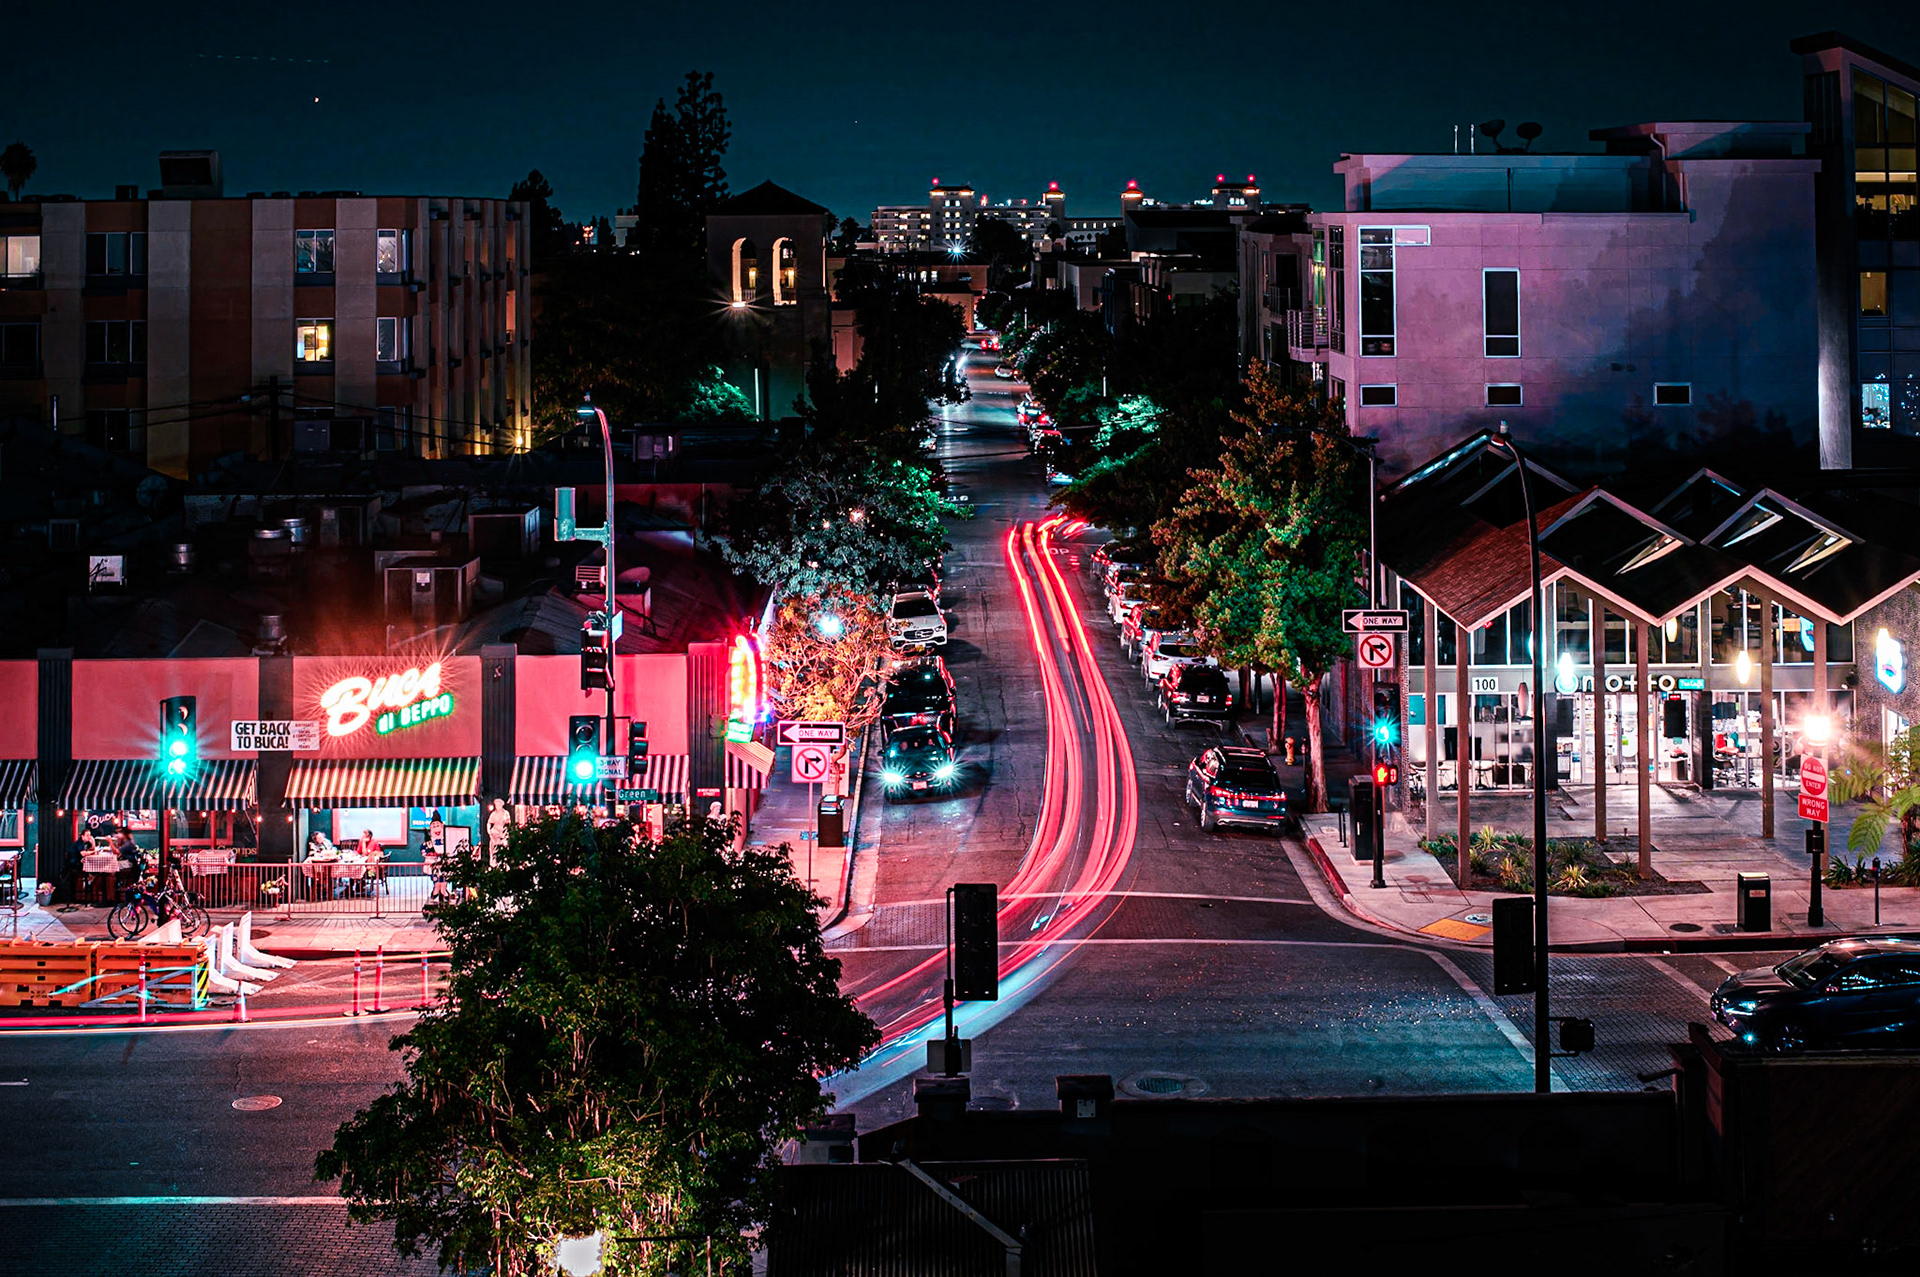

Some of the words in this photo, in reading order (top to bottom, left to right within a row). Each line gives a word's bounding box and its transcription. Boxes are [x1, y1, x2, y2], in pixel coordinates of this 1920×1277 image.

[1475, 679, 1496, 690] 100
[400, 694, 451, 727] BEPPO
[235, 722, 256, 735] GET
[259, 722, 291, 735] BACK
[237, 736, 251, 749] TO
[254, 736, 289, 749] BUCA!
[1813, 764, 1823, 773] NOT
[1806, 780, 1821, 789] ENTER
[619, 789, 645, 798] Green
[1802, 798, 1825, 809] WRONG
